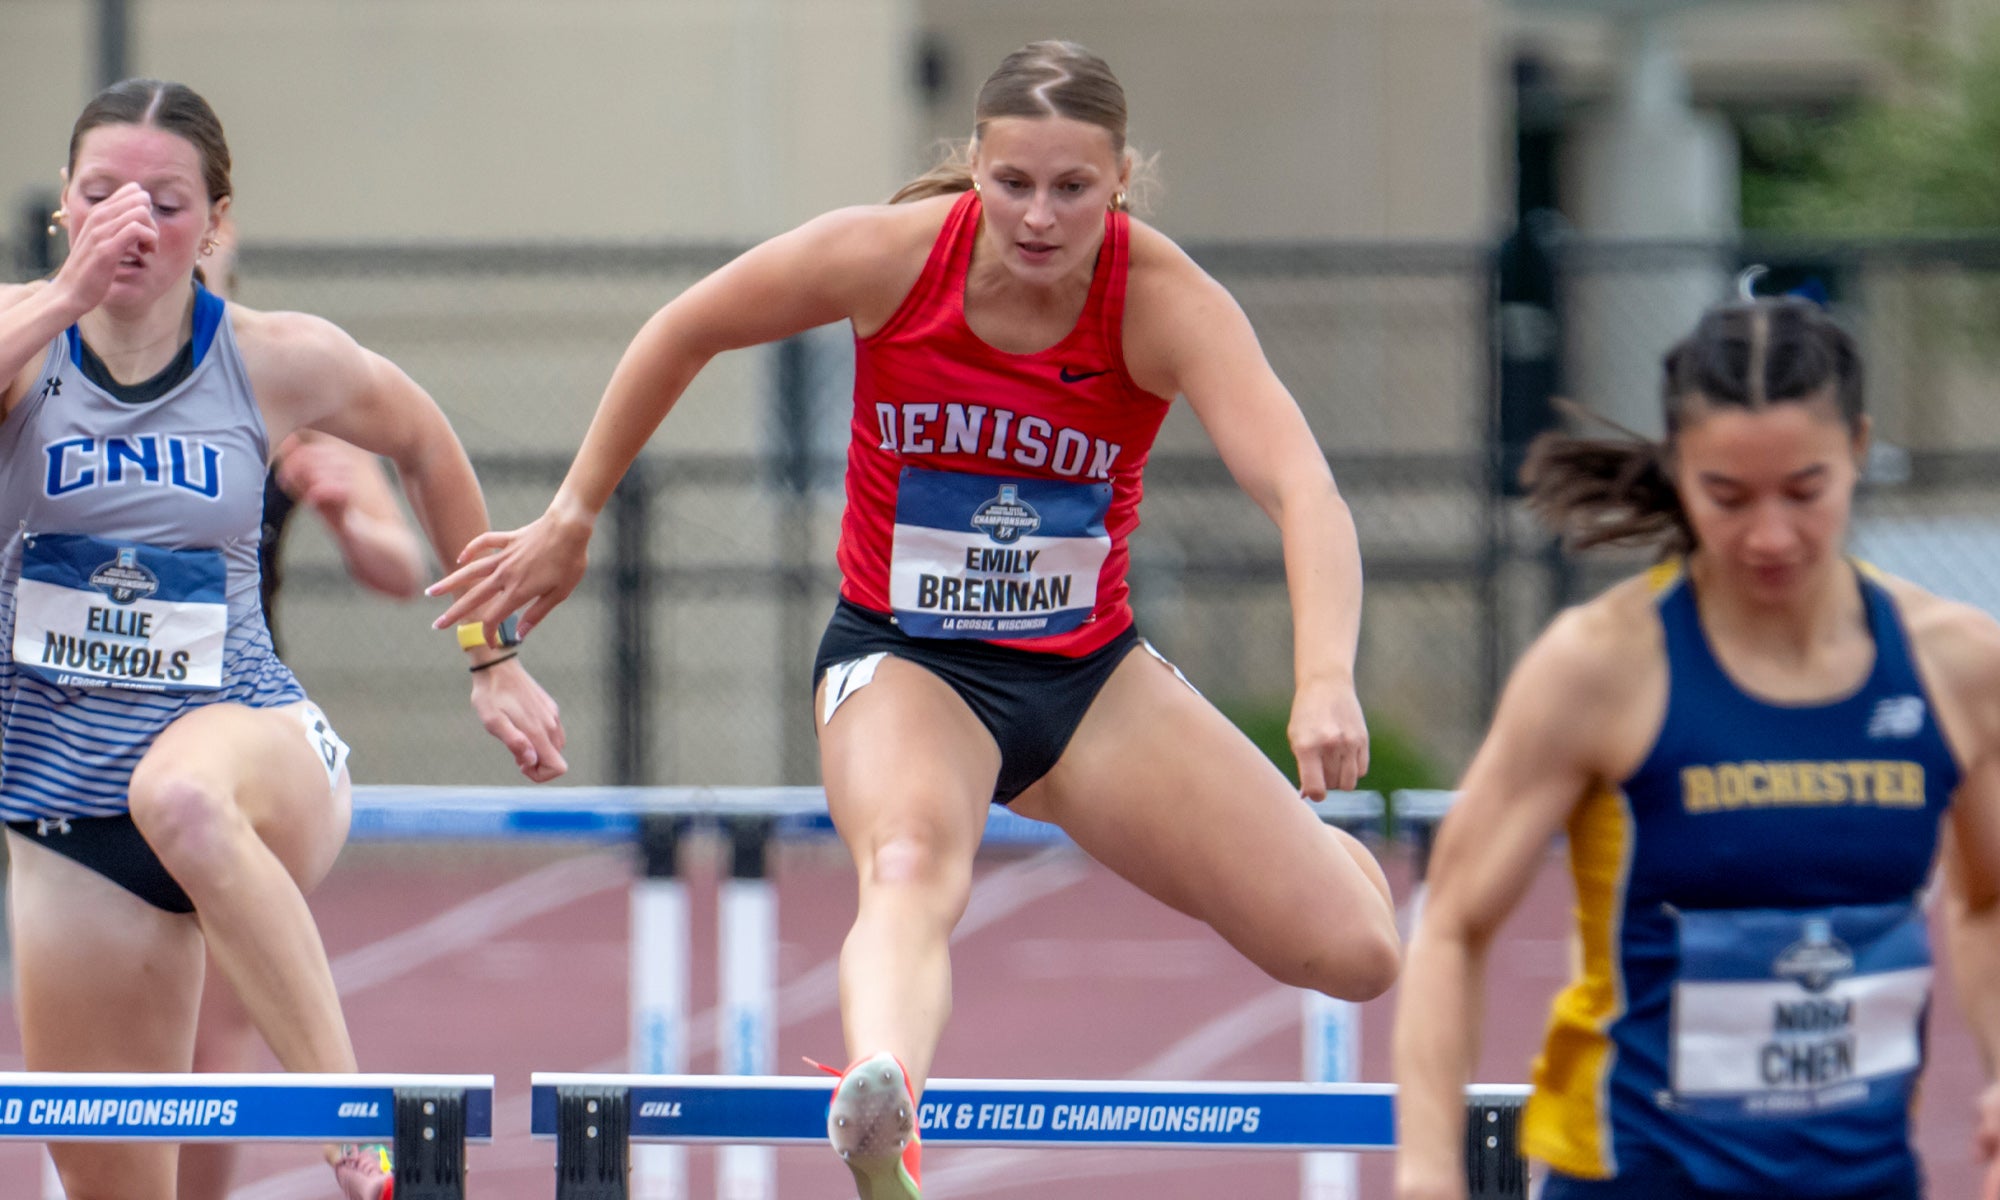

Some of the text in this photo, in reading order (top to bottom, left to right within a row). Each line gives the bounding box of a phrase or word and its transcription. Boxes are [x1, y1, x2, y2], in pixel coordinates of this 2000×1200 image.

[875, 402, 1121, 479] DENISON
[43, 432, 224, 501] CNU
[966, 547, 1040, 574] EMILY
[917, 573, 1072, 613] BRENNAN
[88, 606, 153, 638] ELLIE
[942, 618, 955, 630] LA
[42, 631, 190, 681] NUCKOLS
[1679, 759, 1926, 814] ROCHESTER
[1760, 1038, 1856, 1085] CHEN
[28, 1098, 238, 1126] CHAMPIONSHIPS
[338, 1101, 379, 1118] GILL
[639, 1101, 682, 1117] GILL
[954, 1103, 975, 1130] &
[977, 1104, 1045, 1131] FIELD
[1051, 1104, 1261, 1134] CHAMPIONSHIPS
